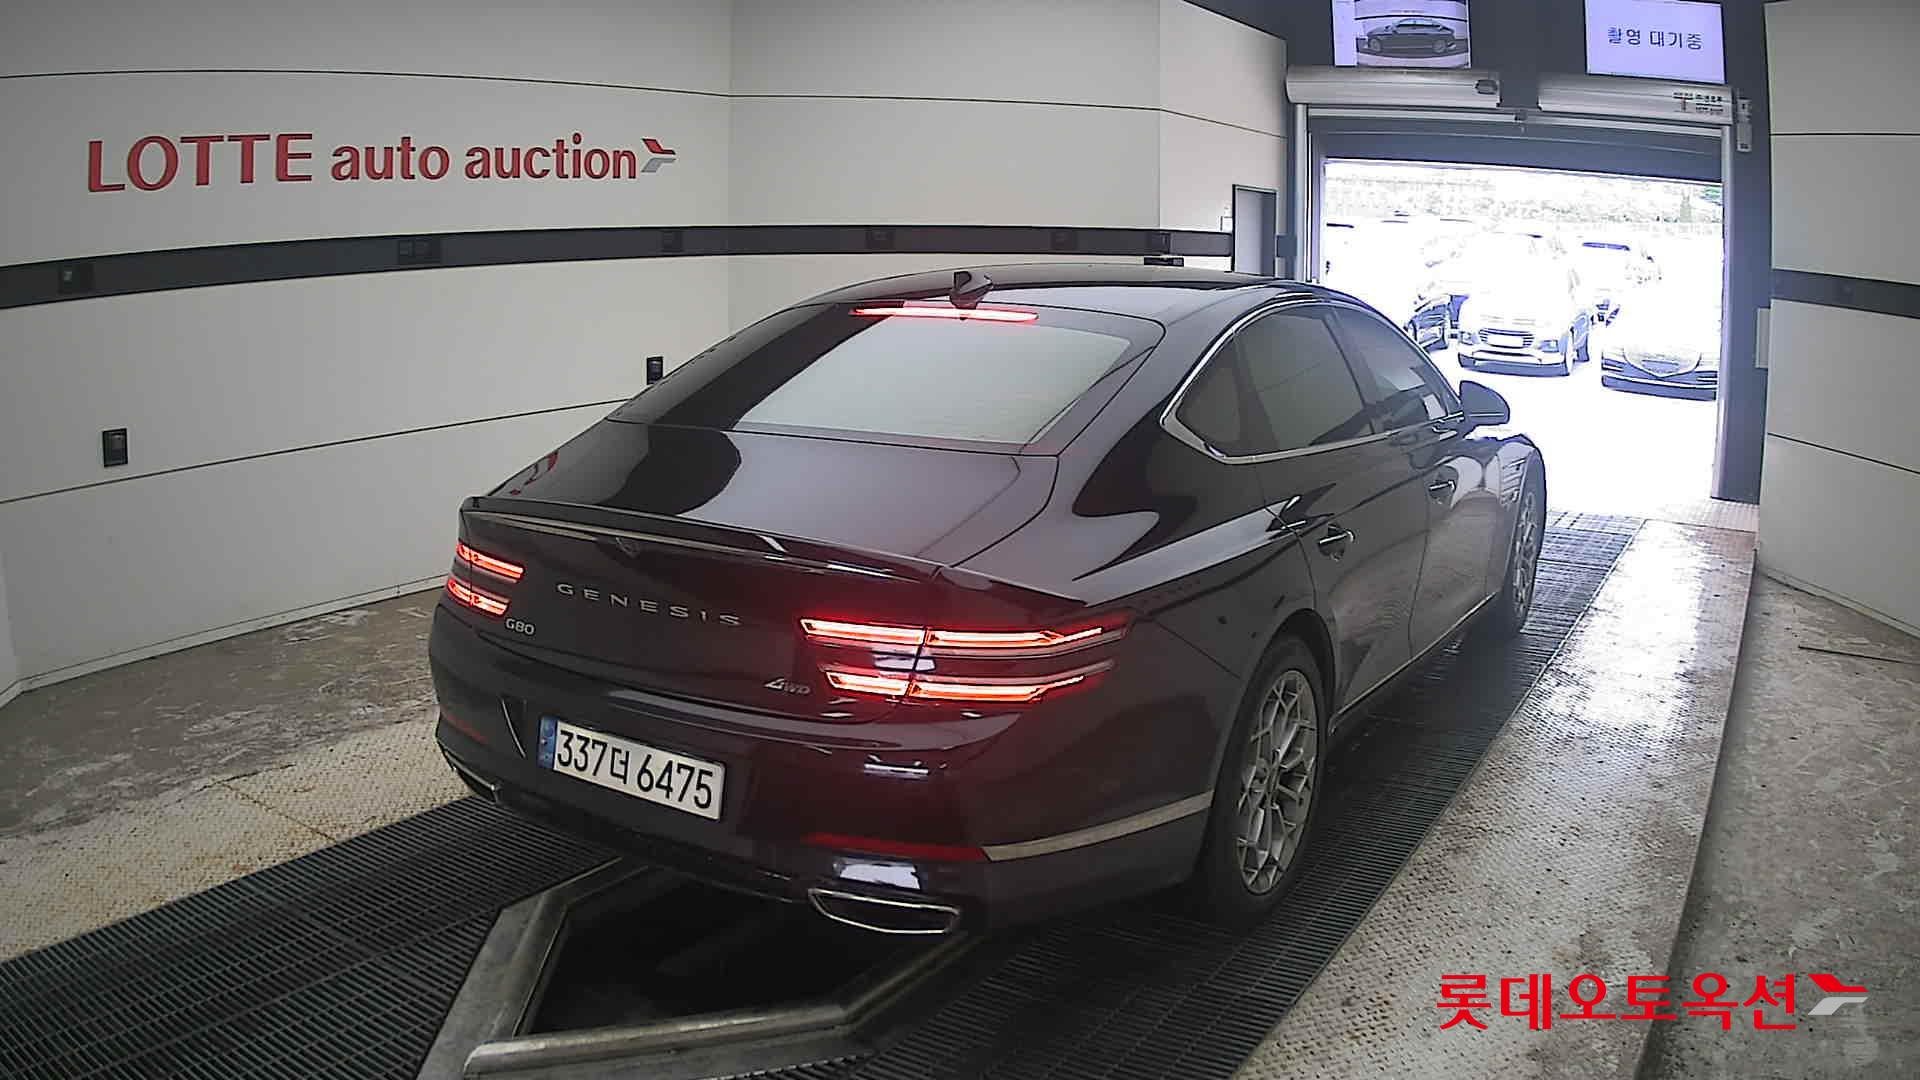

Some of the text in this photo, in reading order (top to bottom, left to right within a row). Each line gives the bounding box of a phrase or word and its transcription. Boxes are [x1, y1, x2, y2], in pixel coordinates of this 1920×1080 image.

[1648, 31, 1702, 50] 대기중
[87, 132, 638, 193] LOTTE auto auction
[505, 618, 535, 635] G80
[556, 583, 742, 627] GENESIS
[556, 729, 713, 810] 337더 6475
